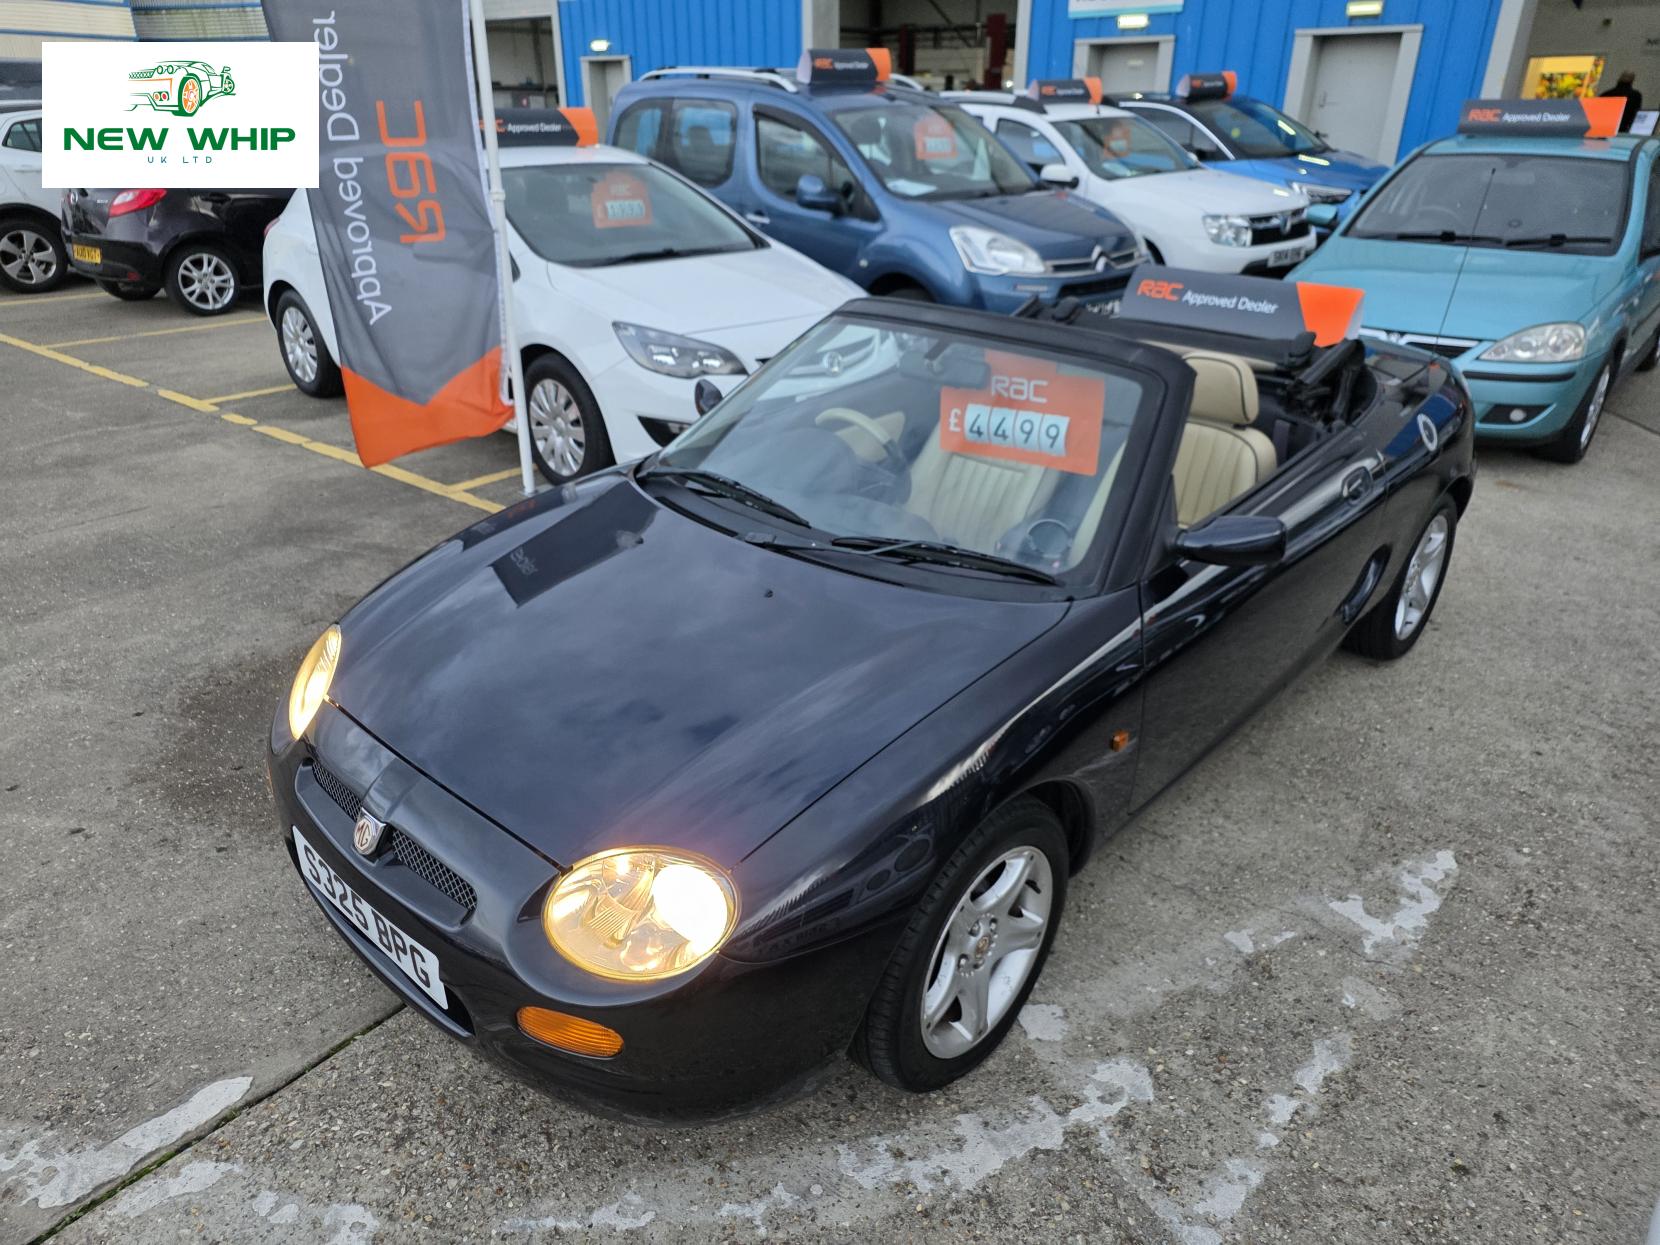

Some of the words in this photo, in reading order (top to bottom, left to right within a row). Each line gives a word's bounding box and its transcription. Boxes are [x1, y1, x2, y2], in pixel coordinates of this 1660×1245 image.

[1182, 289, 1238, 310] Approved
[1237, 296, 1279, 315] Dealer
[304, 844, 369, 931] S325
[371, 908, 431, 989] BPG
